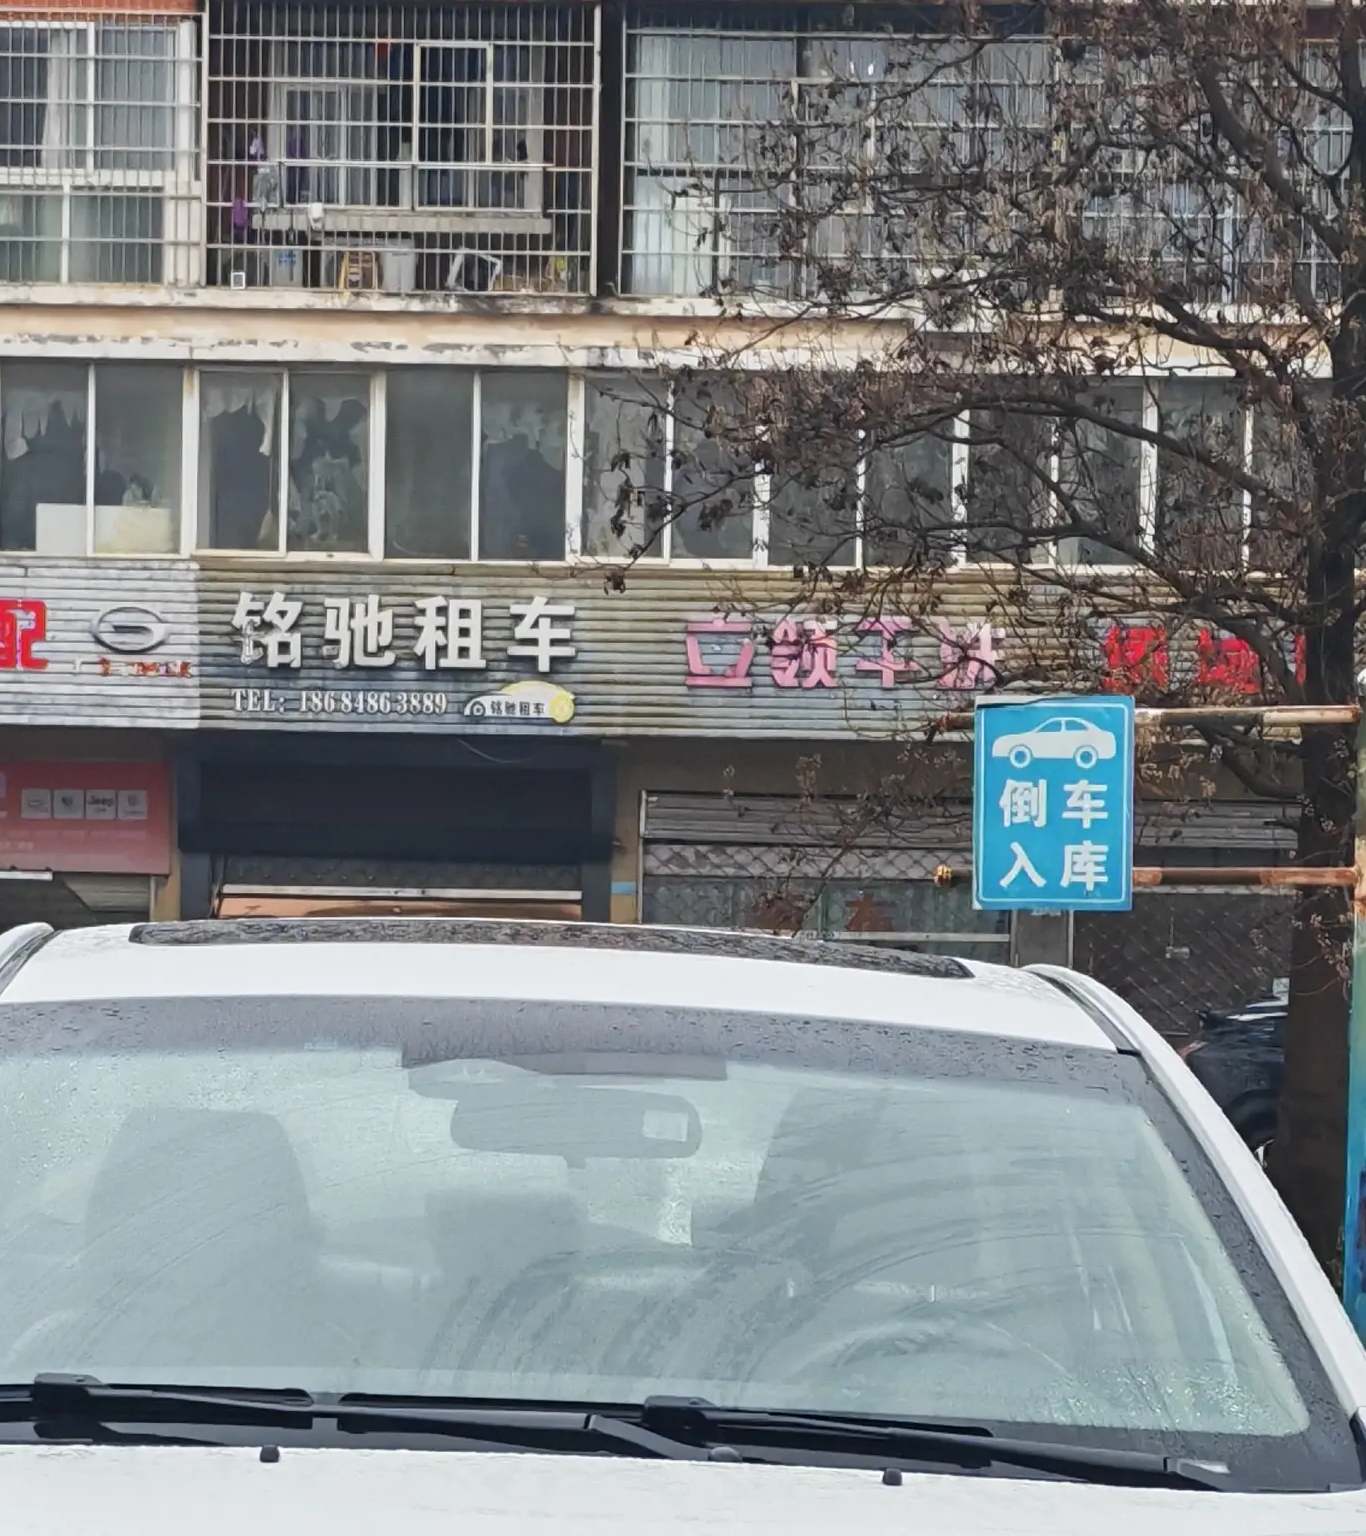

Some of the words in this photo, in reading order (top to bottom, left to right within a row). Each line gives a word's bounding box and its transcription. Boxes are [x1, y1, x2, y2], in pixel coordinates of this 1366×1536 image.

[232, 592, 577, 673] 铭驰租车
[999, 778, 1108, 829] 倒车
[999, 840, 1109, 891] 入库
